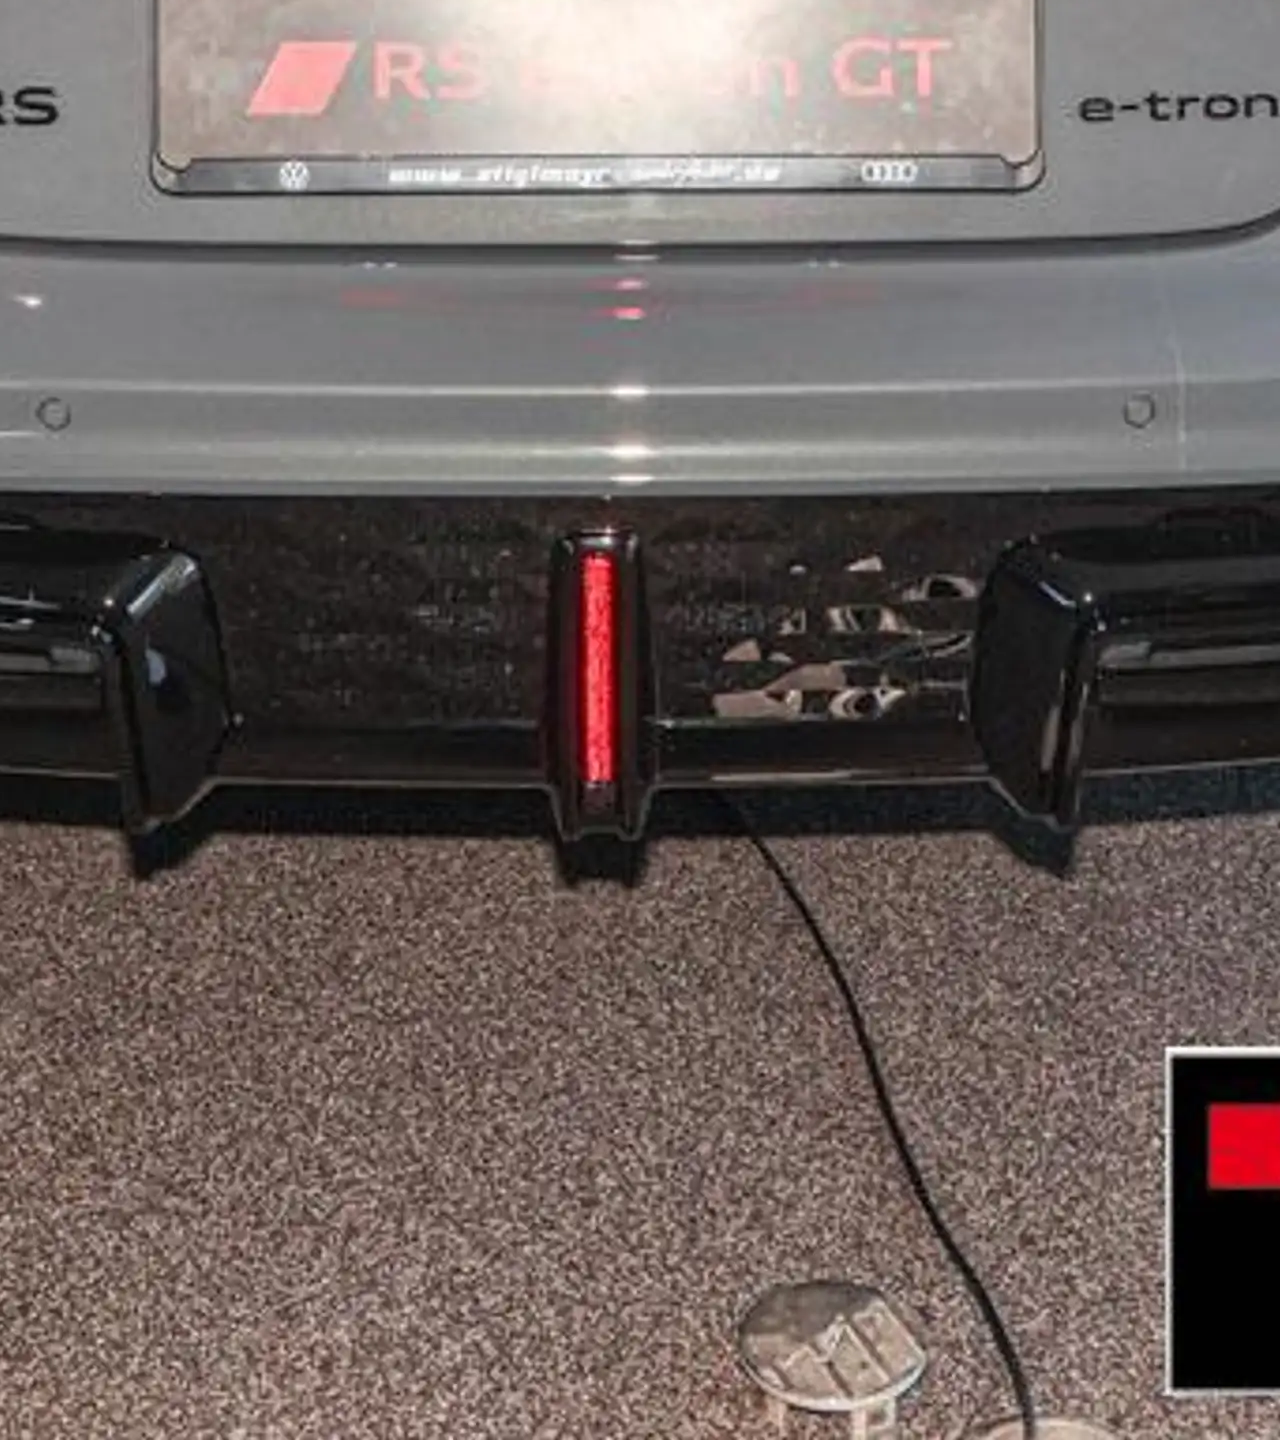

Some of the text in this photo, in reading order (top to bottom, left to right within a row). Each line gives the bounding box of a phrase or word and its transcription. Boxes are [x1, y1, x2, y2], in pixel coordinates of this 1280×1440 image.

[375, 42, 485, 101] RS
[831, 38, 953, 98] GT
[1078, 87, 1280, 123] e-tron
